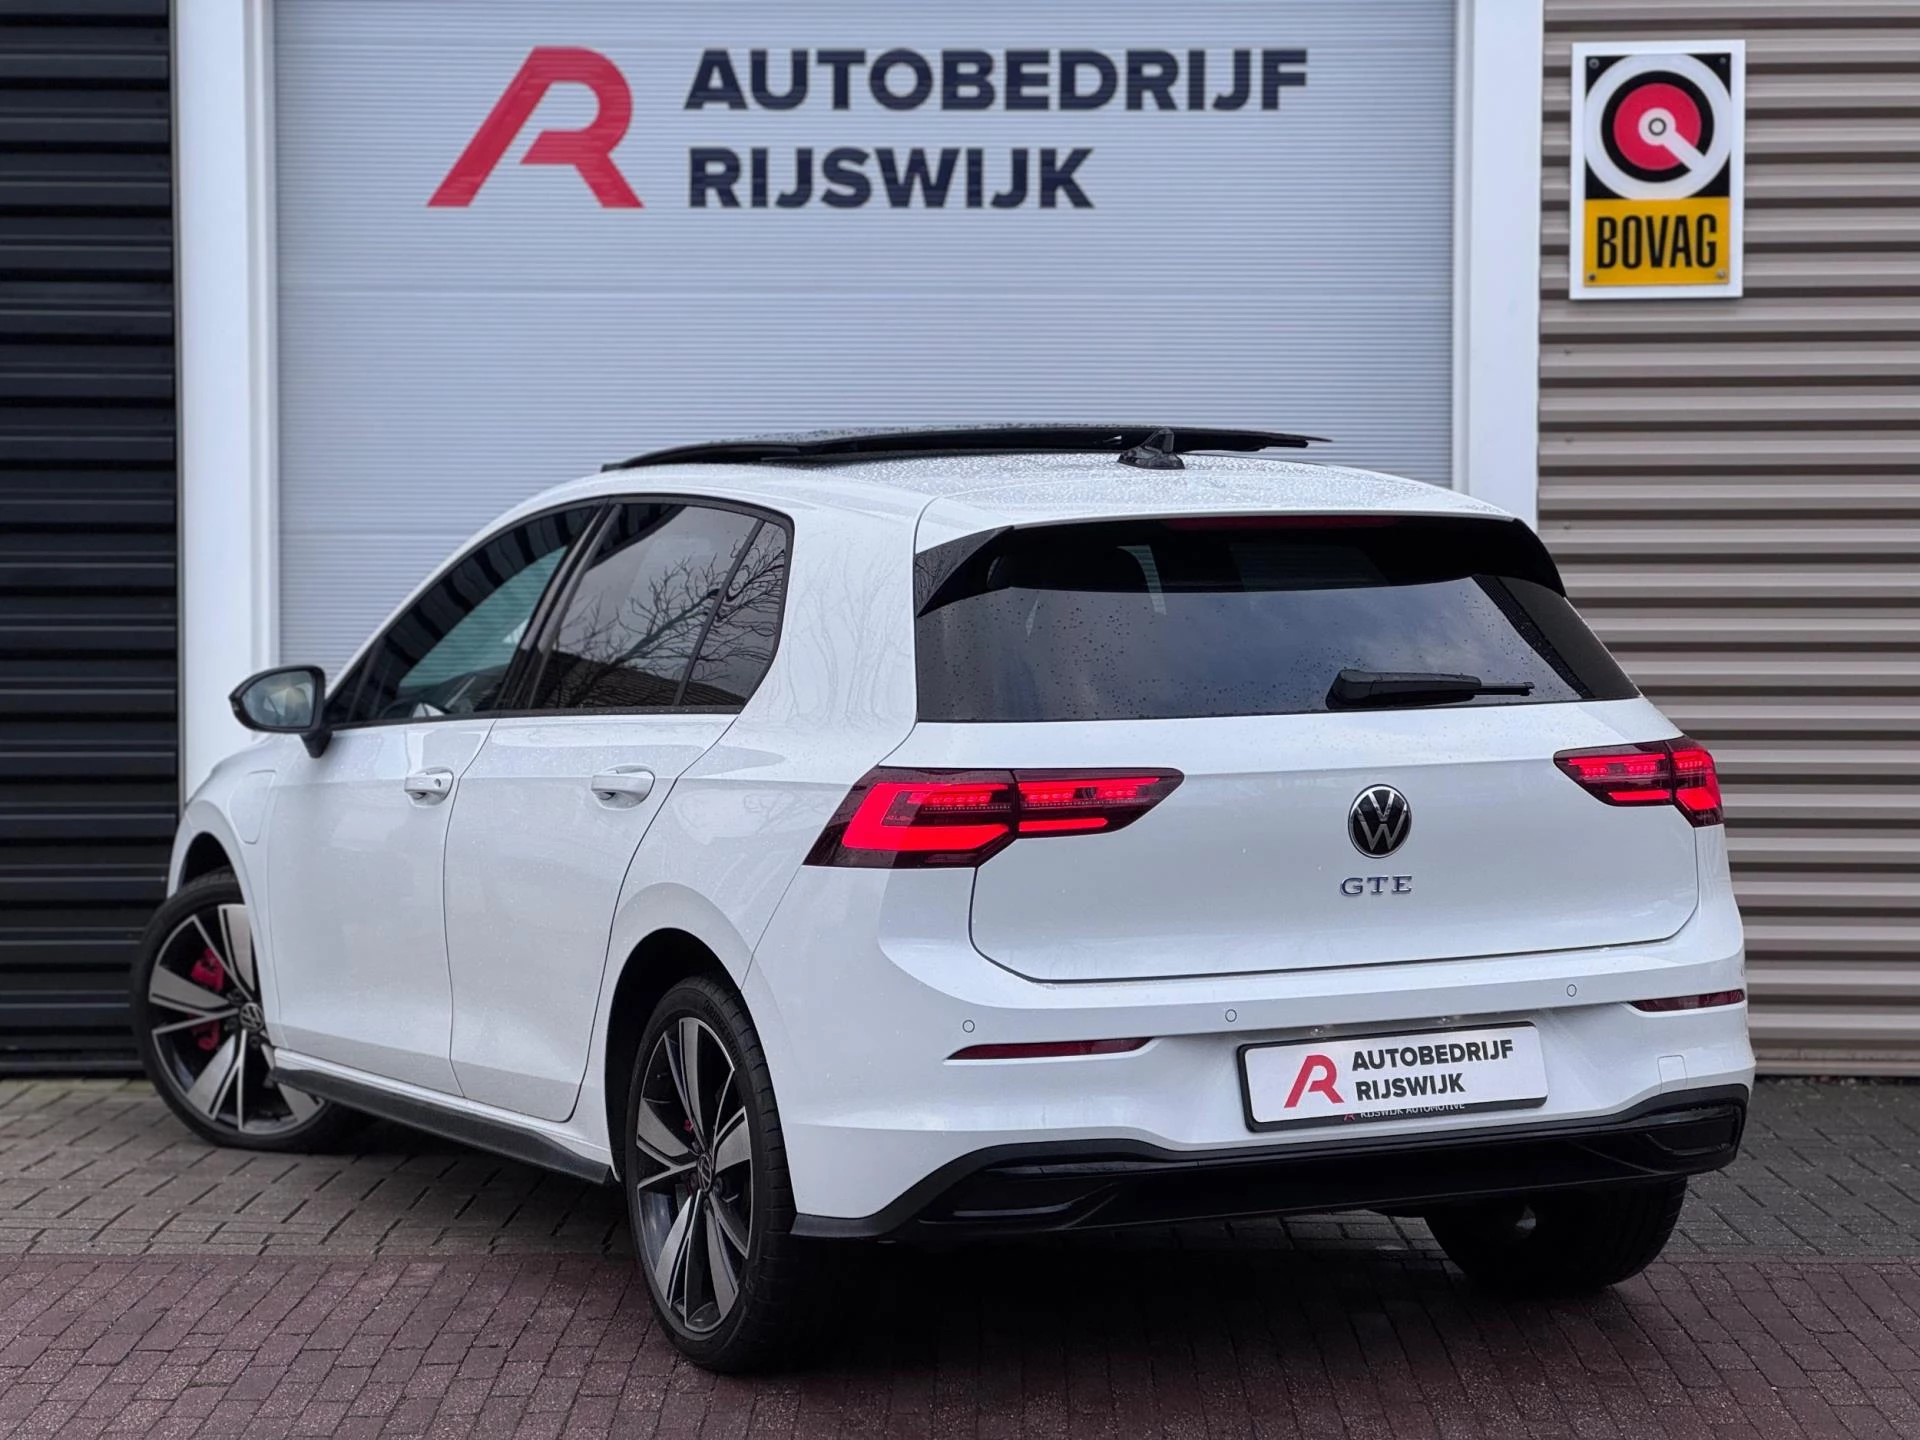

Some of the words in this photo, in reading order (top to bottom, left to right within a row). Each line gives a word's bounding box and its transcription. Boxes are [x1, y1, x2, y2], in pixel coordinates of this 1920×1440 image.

[684, 48, 1308, 111] AUTOBEDRIJF
[689, 147, 1094, 208] RIJSWIJK
[1597, 214, 1717, 269] BOVAG
[1340, 874, 1413, 897] GTE
[1352, 1039, 1513, 1071] AUTOBEDRIJF
[1355, 1073, 1465, 1101] RIJSWIJK
